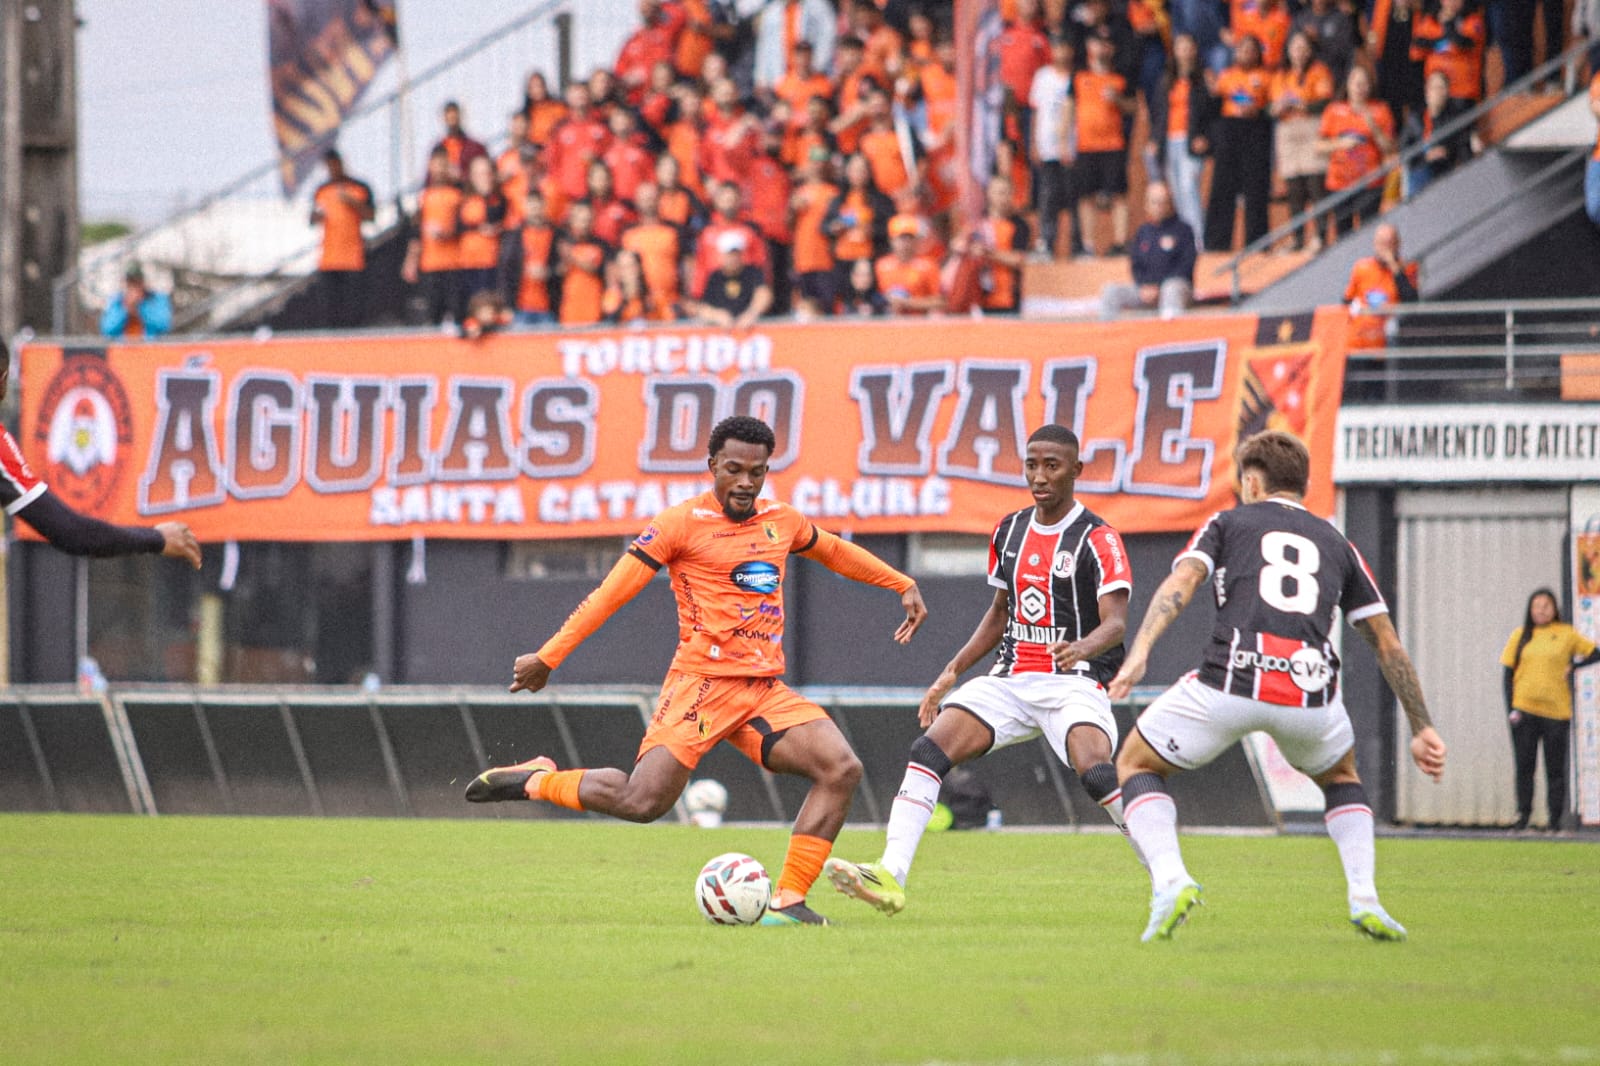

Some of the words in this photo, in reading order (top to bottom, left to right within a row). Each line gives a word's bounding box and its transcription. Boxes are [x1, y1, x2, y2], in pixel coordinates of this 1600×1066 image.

[557, 335, 772, 377] TORCIDA
[138, 353, 597, 515] ÁGUIAS
[638, 370, 805, 474] DO
[849, 338, 1228, 499] VALE
[1344, 424, 1496, 459] TREINAMENTO
[1505, 423, 1530, 458] DE
[370, 484, 525, 525] SANTA
[1259, 531, 1320, 615] 8
[1233, 650, 1290, 673] grupo
